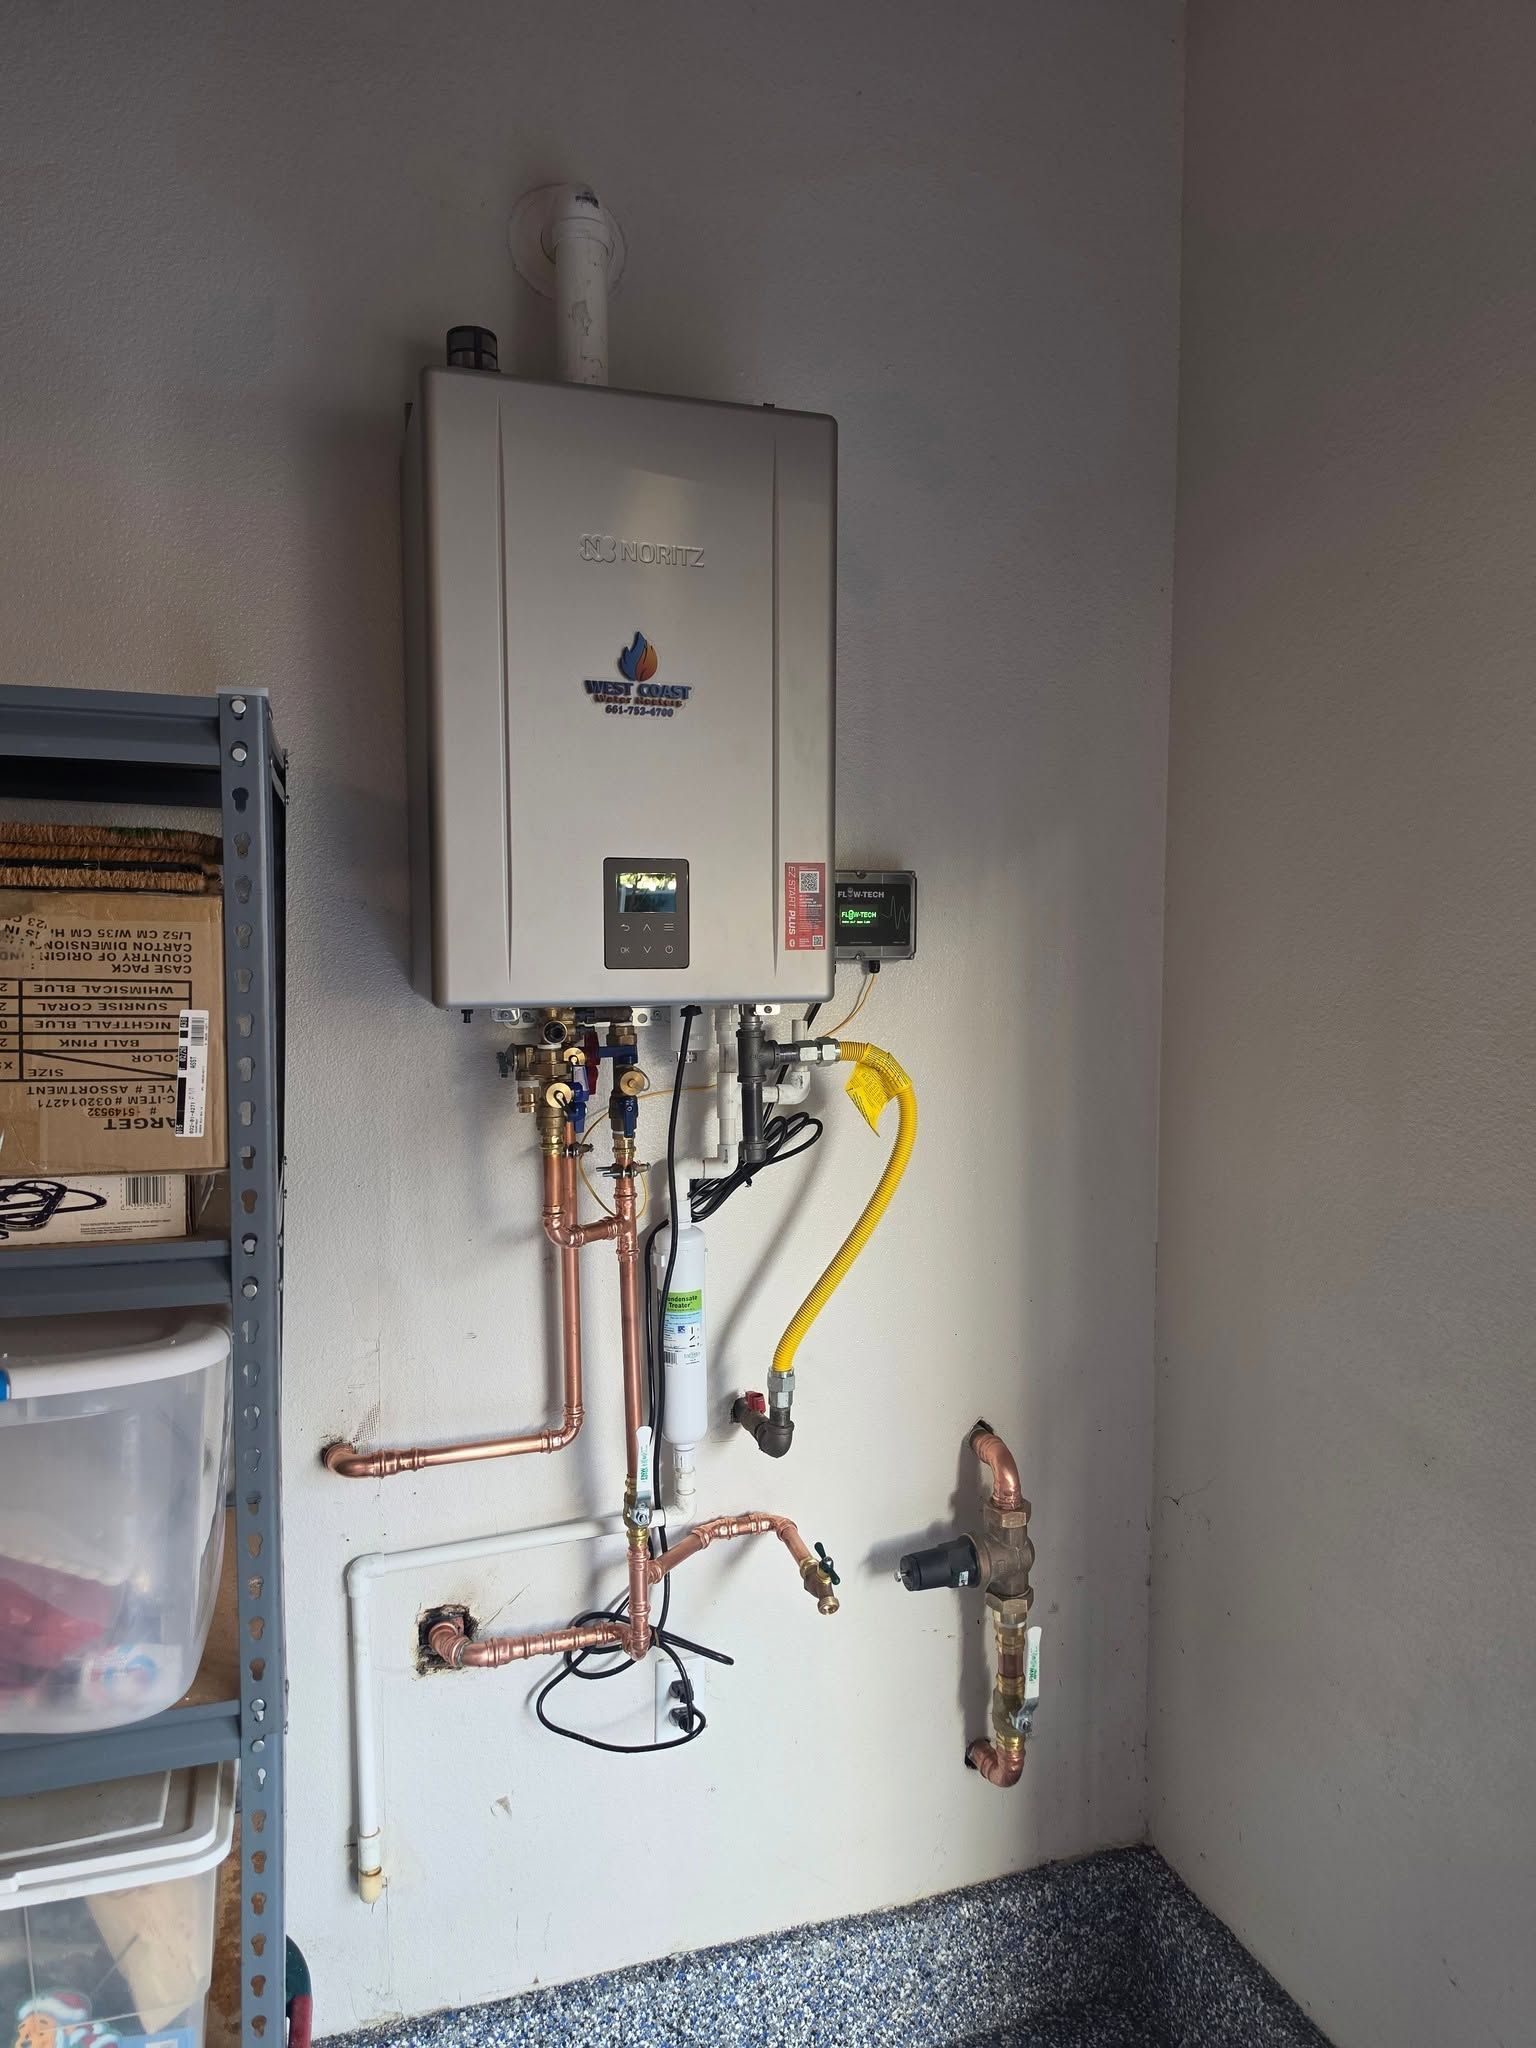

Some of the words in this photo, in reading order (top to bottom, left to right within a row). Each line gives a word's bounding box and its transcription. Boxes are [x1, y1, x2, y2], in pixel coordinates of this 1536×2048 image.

[621, 540, 705, 568] NORITZ
[584, 680, 634, 696] WEST
[637, 683, 692, 700] COAST
[788, 879, 796, 907] START
[788, 910, 796, 935] PLUS
[70, 929, 92, 938] CM
[137, 930, 157, 939] CM
[133, 942, 192, 952] CARTON
[620, 946, 630, 954] OK
[98, 952, 116, 962] OF
[122, 953, 192, 963] COUNTRY
[112, 964, 149, 973] PACK
[154, 964, 192, 974] CASE
[34, 984, 76, 993] BLUE
[82, 984, 174, 994] WHIMSICAL
[38, 1002, 92, 1011] CORAL
[98, 1002, 168, 1011] SUNRISE
[35, 1020, 76, 1029] BLUE
[83, 1021, 171, 1030] NIGHTFALL
[59, 1038, 98, 1047] PINK
[104, 1039, 140, 1048] BALI
[131, 1054, 178, 1063] OLOR
[28, 1068, 64, 1077] SIZE
[26, 1085, 128, 1095] ASSORTMENT
[149, 1085, 175, 1094] YLE
[38, 1098, 112, 1109] 032014271
[128, 1095, 176, 1104] C-ITEM
[87, 1108, 135, 1117] 5149532
[103, 1117, 176, 1131] ARGET
